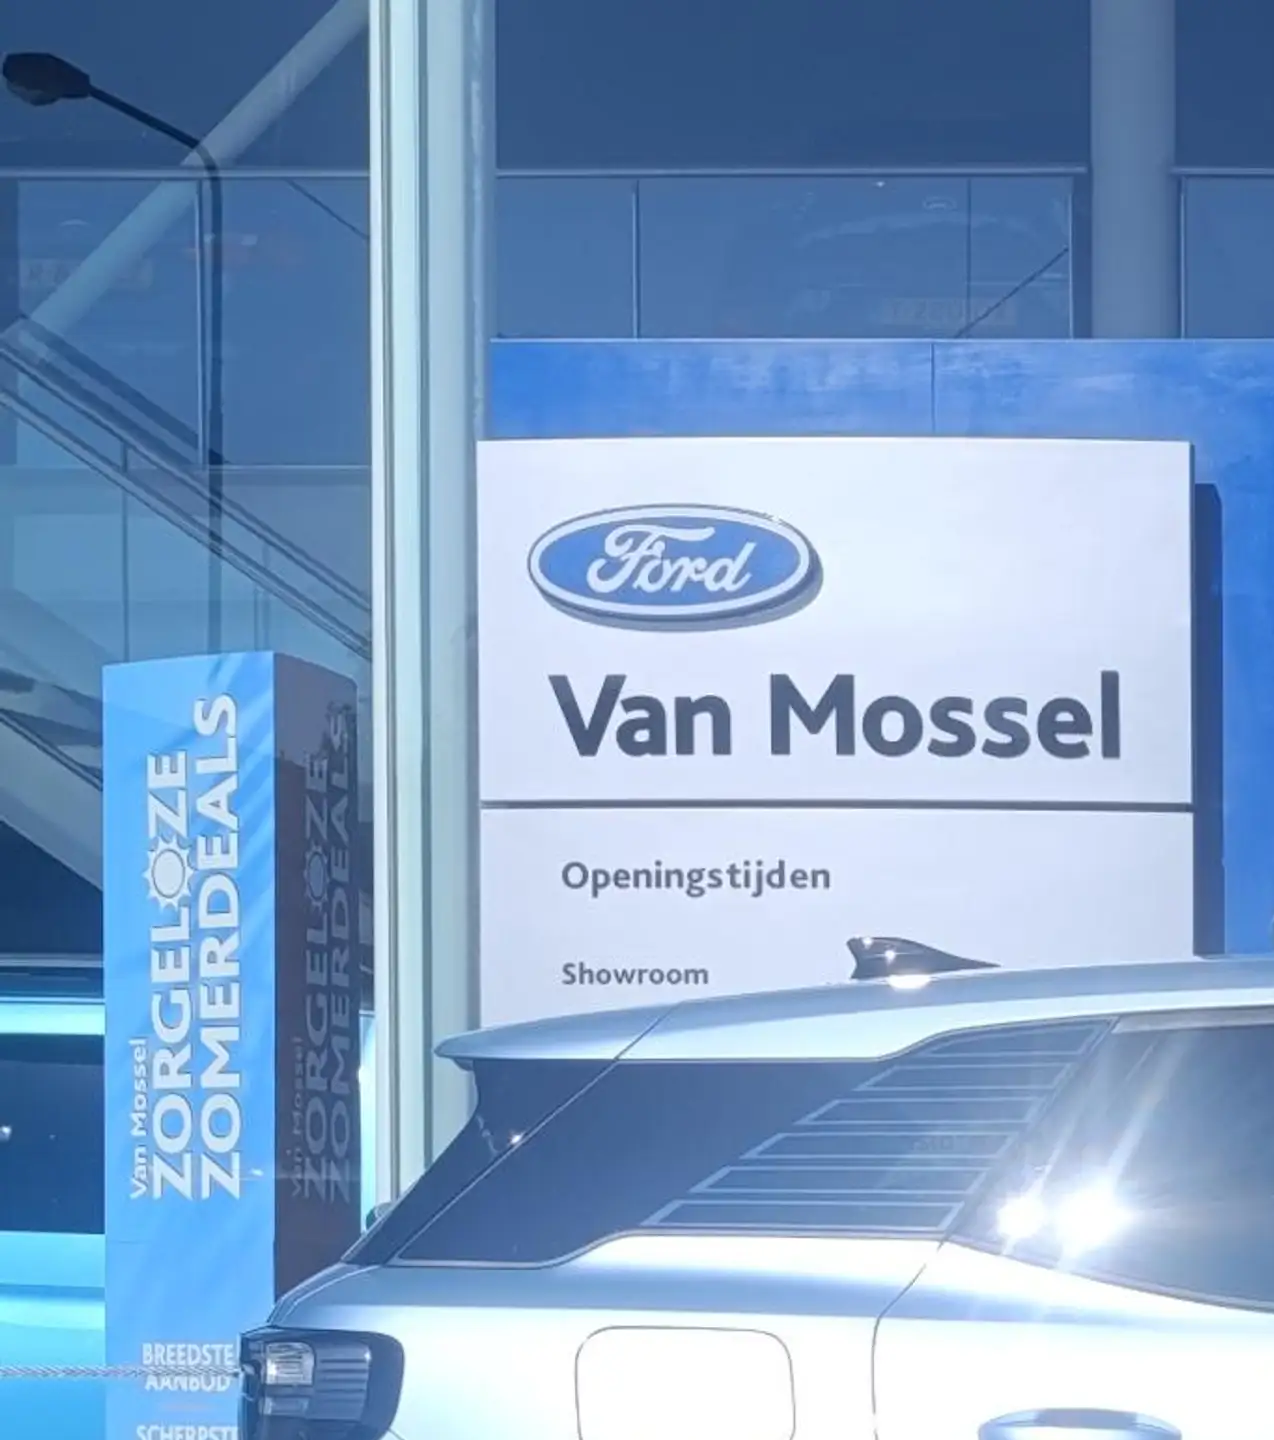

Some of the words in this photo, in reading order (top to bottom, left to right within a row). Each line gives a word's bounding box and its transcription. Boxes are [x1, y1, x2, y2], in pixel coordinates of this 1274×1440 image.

[586, 524, 756, 594] Ford
[548, 674, 732, 757] Van
[769, 670, 1121, 760] Mossel
[560, 861, 832, 898] Openingstijden
[193, 692, 241, 1201] ZOMERDEALS
[561, 962, 710, 988] Showroom
[128, 1037, 148, 1137] Mossel
[128, 1144, 148, 1199] Van
[142, 1343, 234, 1366] BREEDSTE
